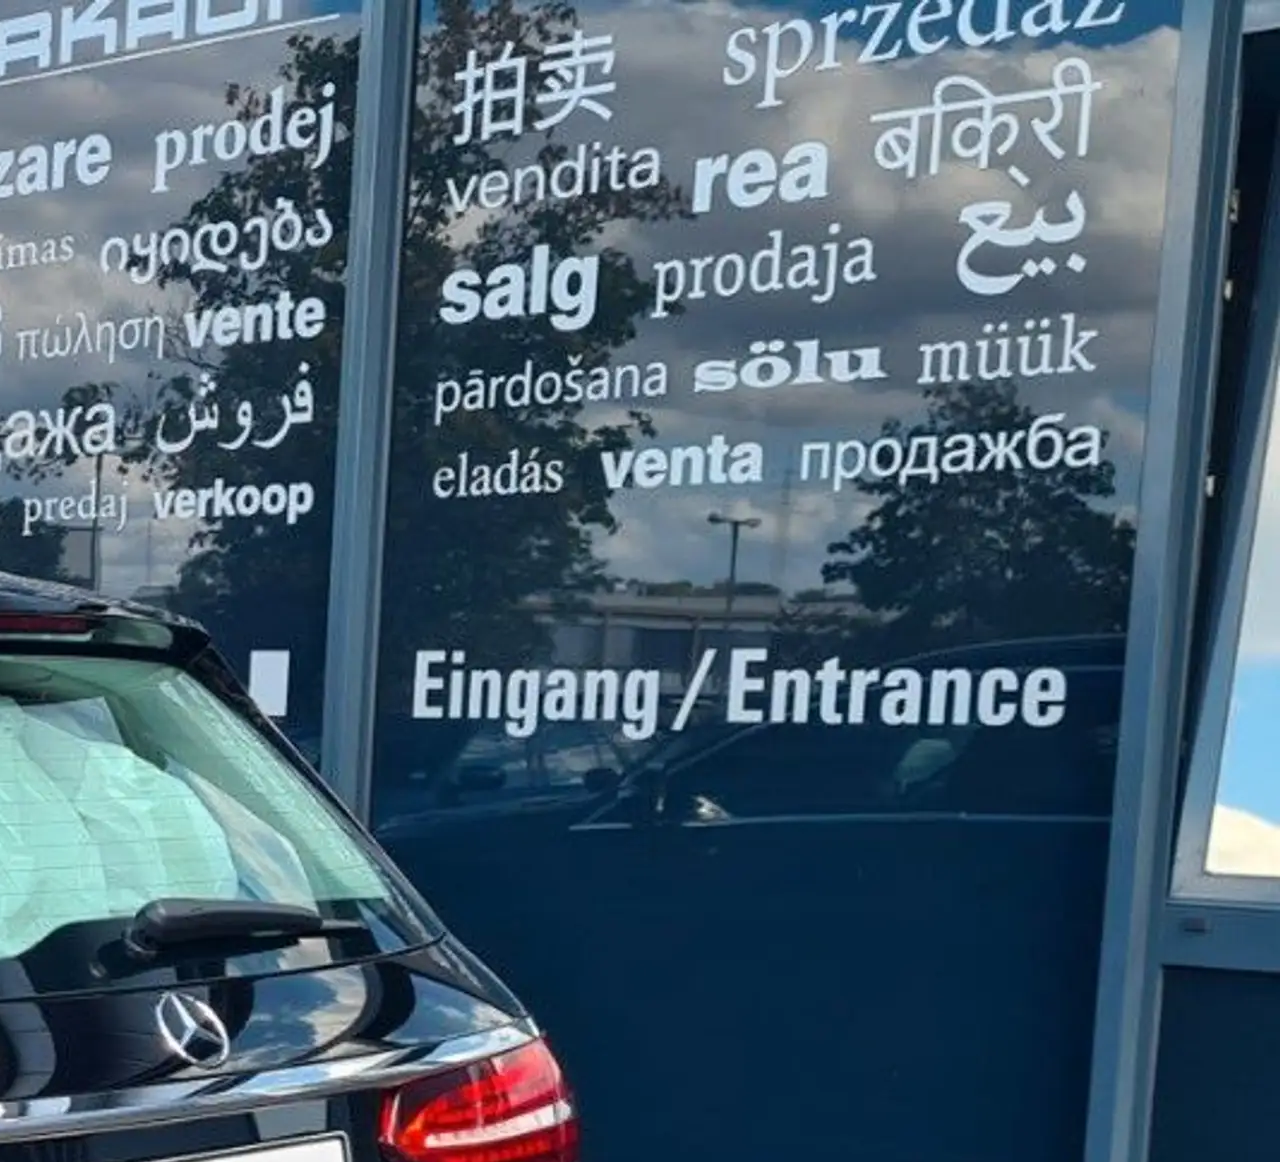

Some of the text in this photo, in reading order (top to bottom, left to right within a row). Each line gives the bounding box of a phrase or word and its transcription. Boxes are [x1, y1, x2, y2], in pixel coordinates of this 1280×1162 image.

[452, 28, 617, 146] 拍卖
[151, 81, 336, 194] prodej
[445, 140, 830, 213] vendita rea
[100, 196, 334, 284] იყიდება
[438, 222, 878, 333] salg prodaja
[15, 312, 166, 364] πώληση
[182, 289, 327, 350] vente
[433, 312, 1100, 426] pārdošana sölu müük
[431, 433, 765, 499] eladás venta
[799, 411, 1102, 493] продажба
[21, 478, 130, 538] predaj
[153, 475, 316, 525] verkoop
[411, 648, 661, 742] Eingang
[724, 647, 1069, 728] Entrance
